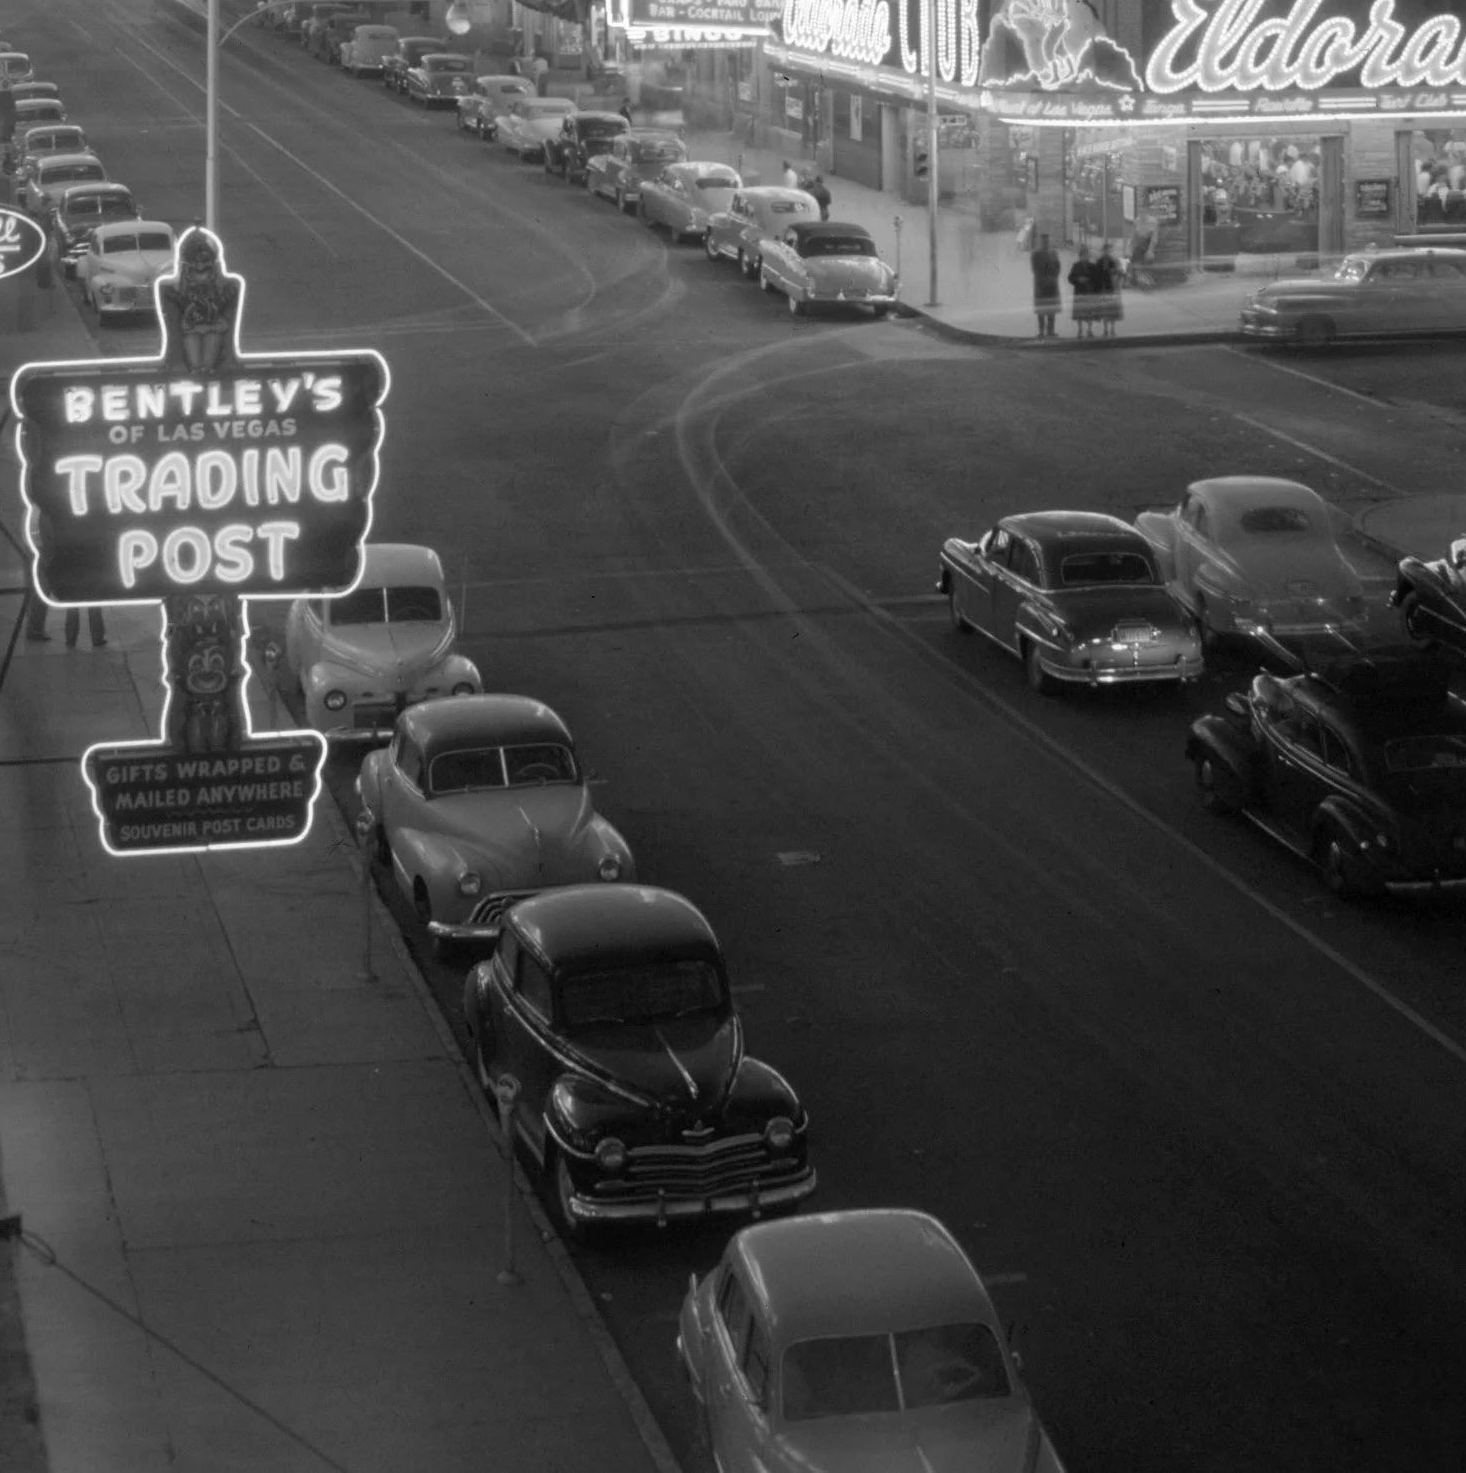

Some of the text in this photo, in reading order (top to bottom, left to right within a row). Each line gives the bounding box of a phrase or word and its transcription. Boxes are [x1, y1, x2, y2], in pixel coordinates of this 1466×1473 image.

[650, 4, 675, 17] BAR
[687, 6, 745, 21] COCKTAIL
[64, 375, 343, 423] BENTLEY'S
[109, 418, 296, 444] OF LAS VEGAS
[55, 444, 350, 516] TRADING
[118, 522, 300, 588] POST
[105, 754, 306, 784] GIFTS WRAPPED &
[115, 779, 304, 810] MAILED ANYWHERE
[120, 813, 296, 842] SOUVENIR POST CARDS
